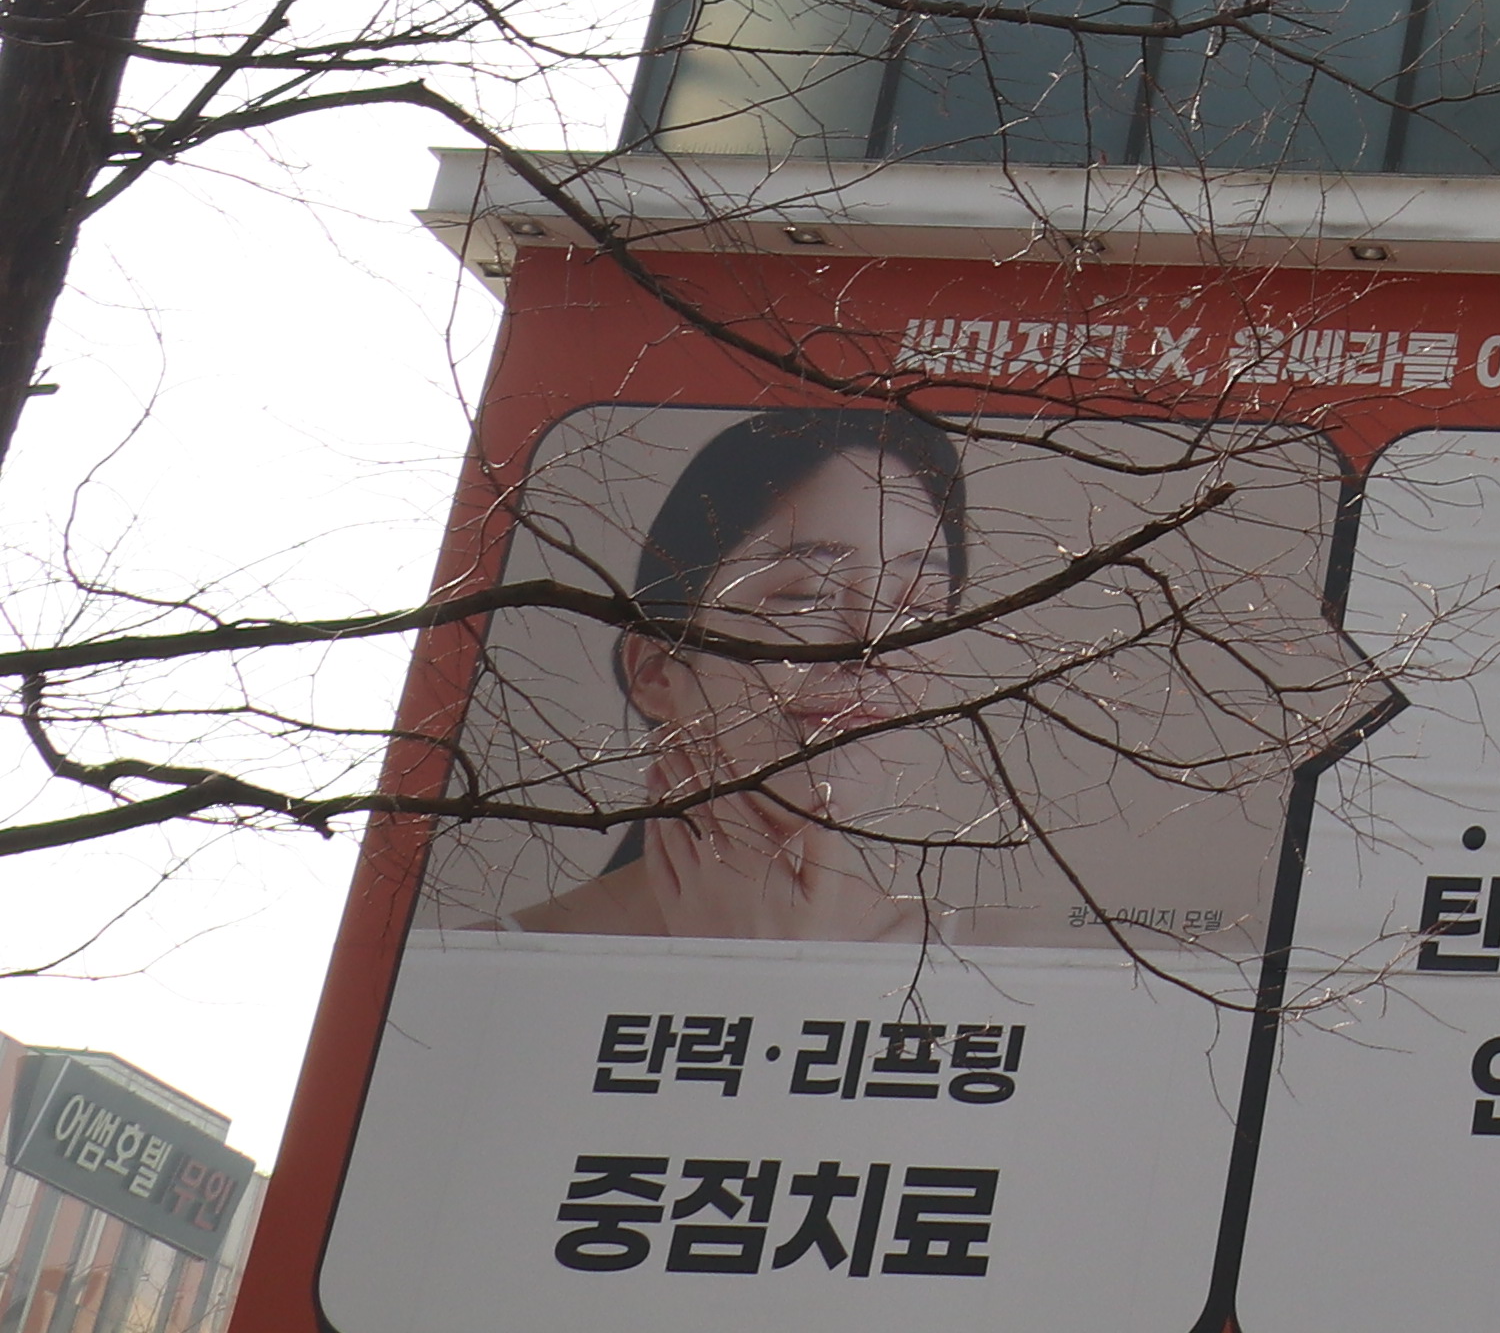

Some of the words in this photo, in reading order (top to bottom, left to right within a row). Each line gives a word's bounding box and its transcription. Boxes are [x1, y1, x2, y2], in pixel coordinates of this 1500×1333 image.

[1116, 907, 1177, 931] 이미지
[1183, 908, 1224, 932] 모델
[553, 1153, 1001, 1278] 중점치료
